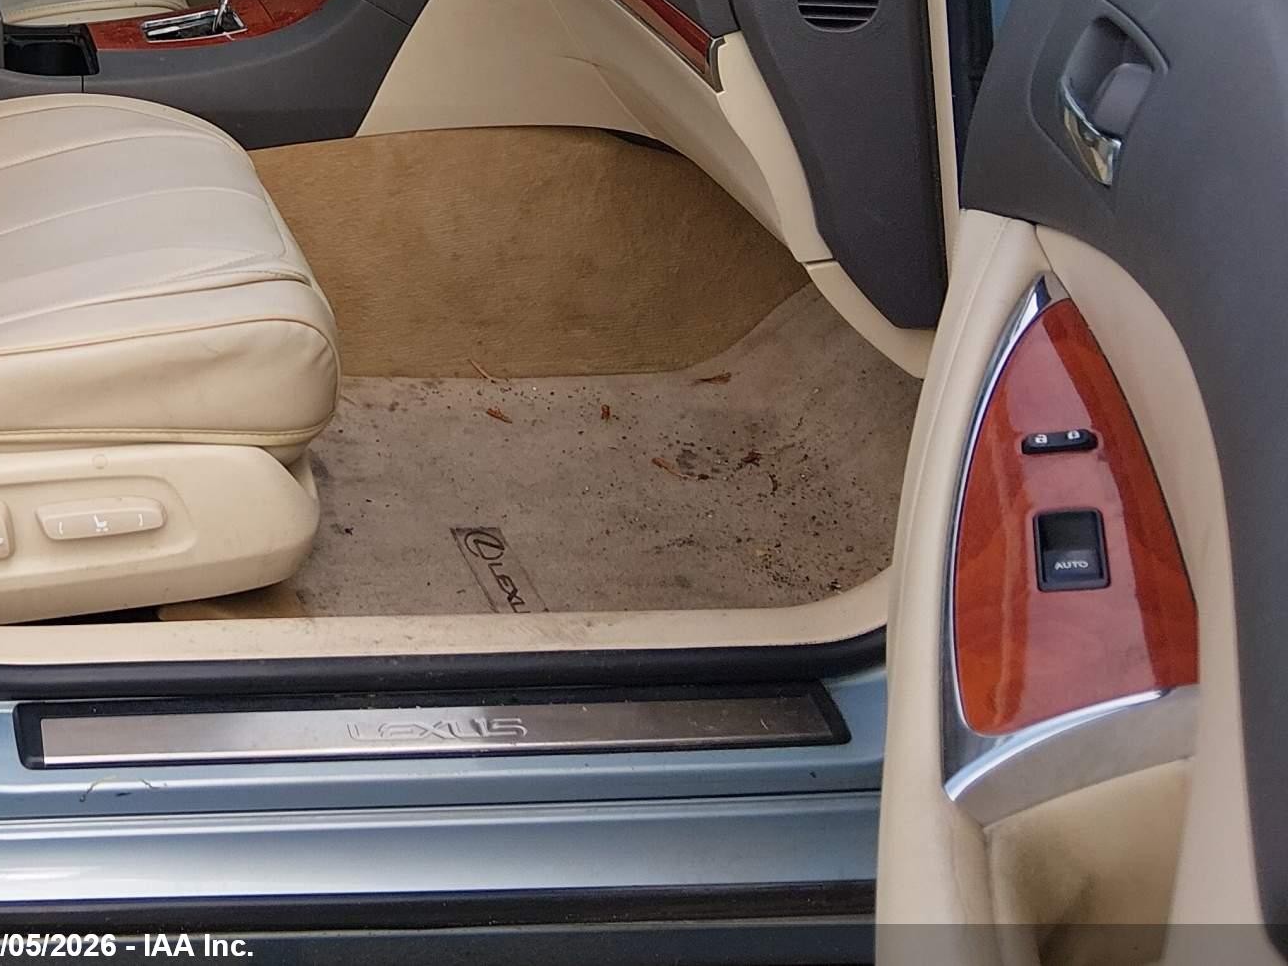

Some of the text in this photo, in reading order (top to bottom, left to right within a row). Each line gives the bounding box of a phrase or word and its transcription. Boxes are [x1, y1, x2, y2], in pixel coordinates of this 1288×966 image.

[1054, 560, 1089, 571] AUTO
[488, 562, 531, 614] LEXU
[346, 718, 528, 741] LEXUS
